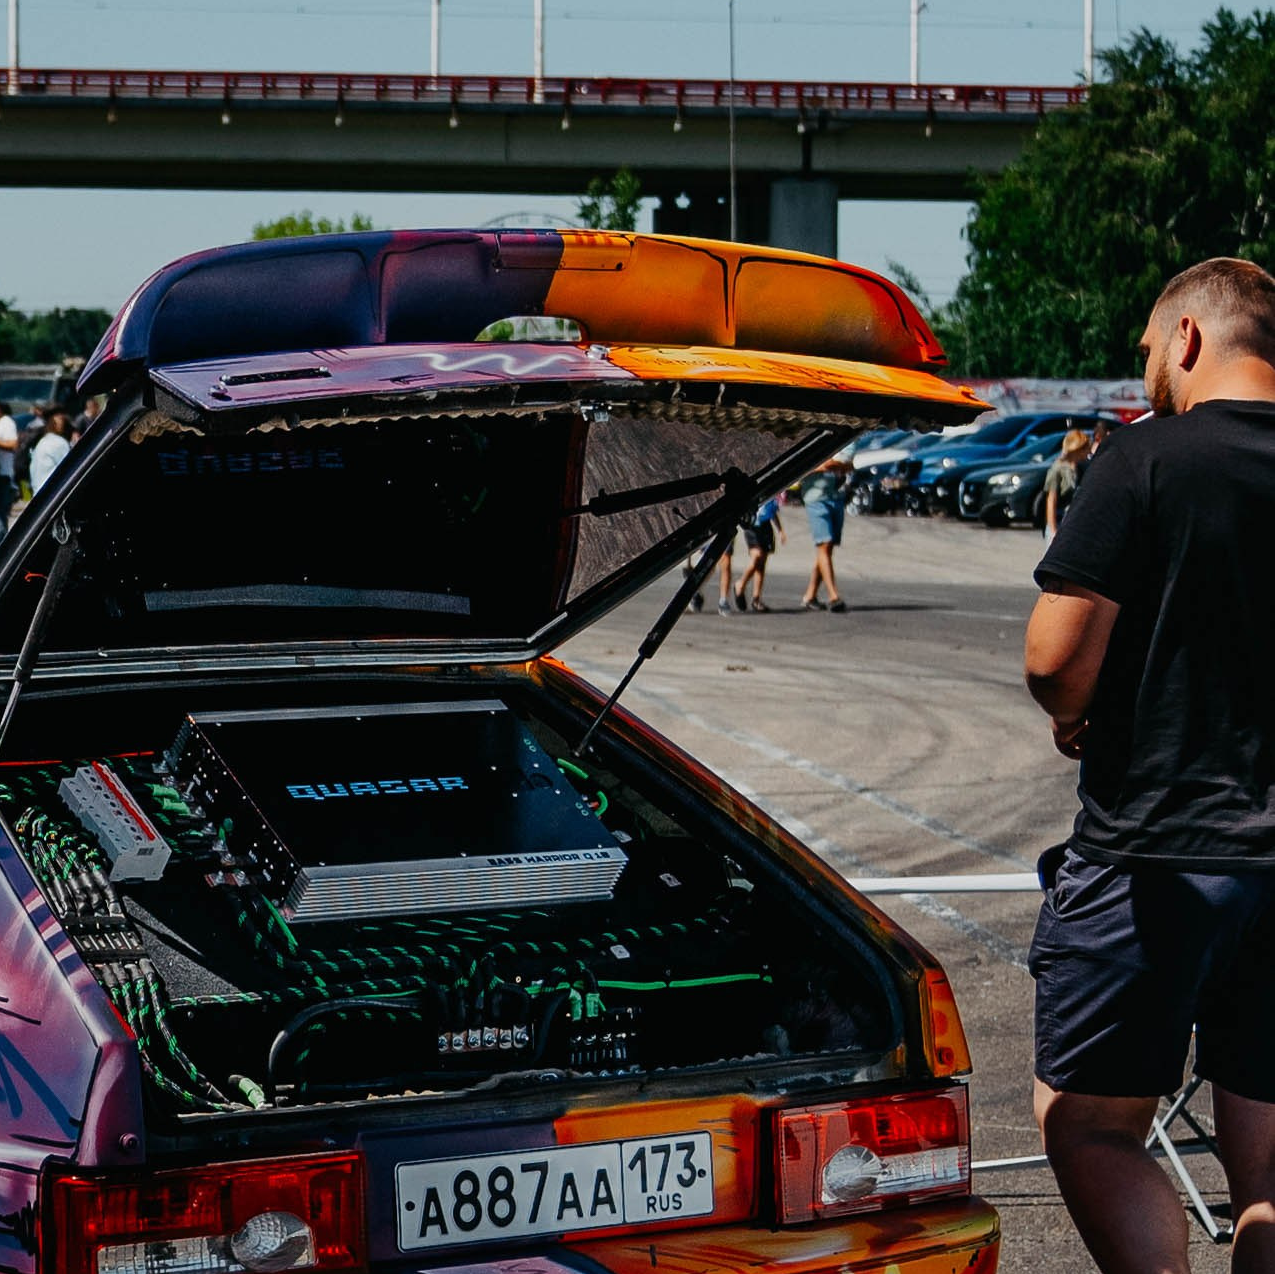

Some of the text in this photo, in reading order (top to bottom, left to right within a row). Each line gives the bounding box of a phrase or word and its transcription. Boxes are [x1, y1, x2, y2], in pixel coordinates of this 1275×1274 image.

[286, 777, 468, 800] QUASAR
[524, 853, 580, 864] WARRIOR
[418, 1141, 697, 1238] A887AA 173
[646, 1192, 682, 1214] RUS
